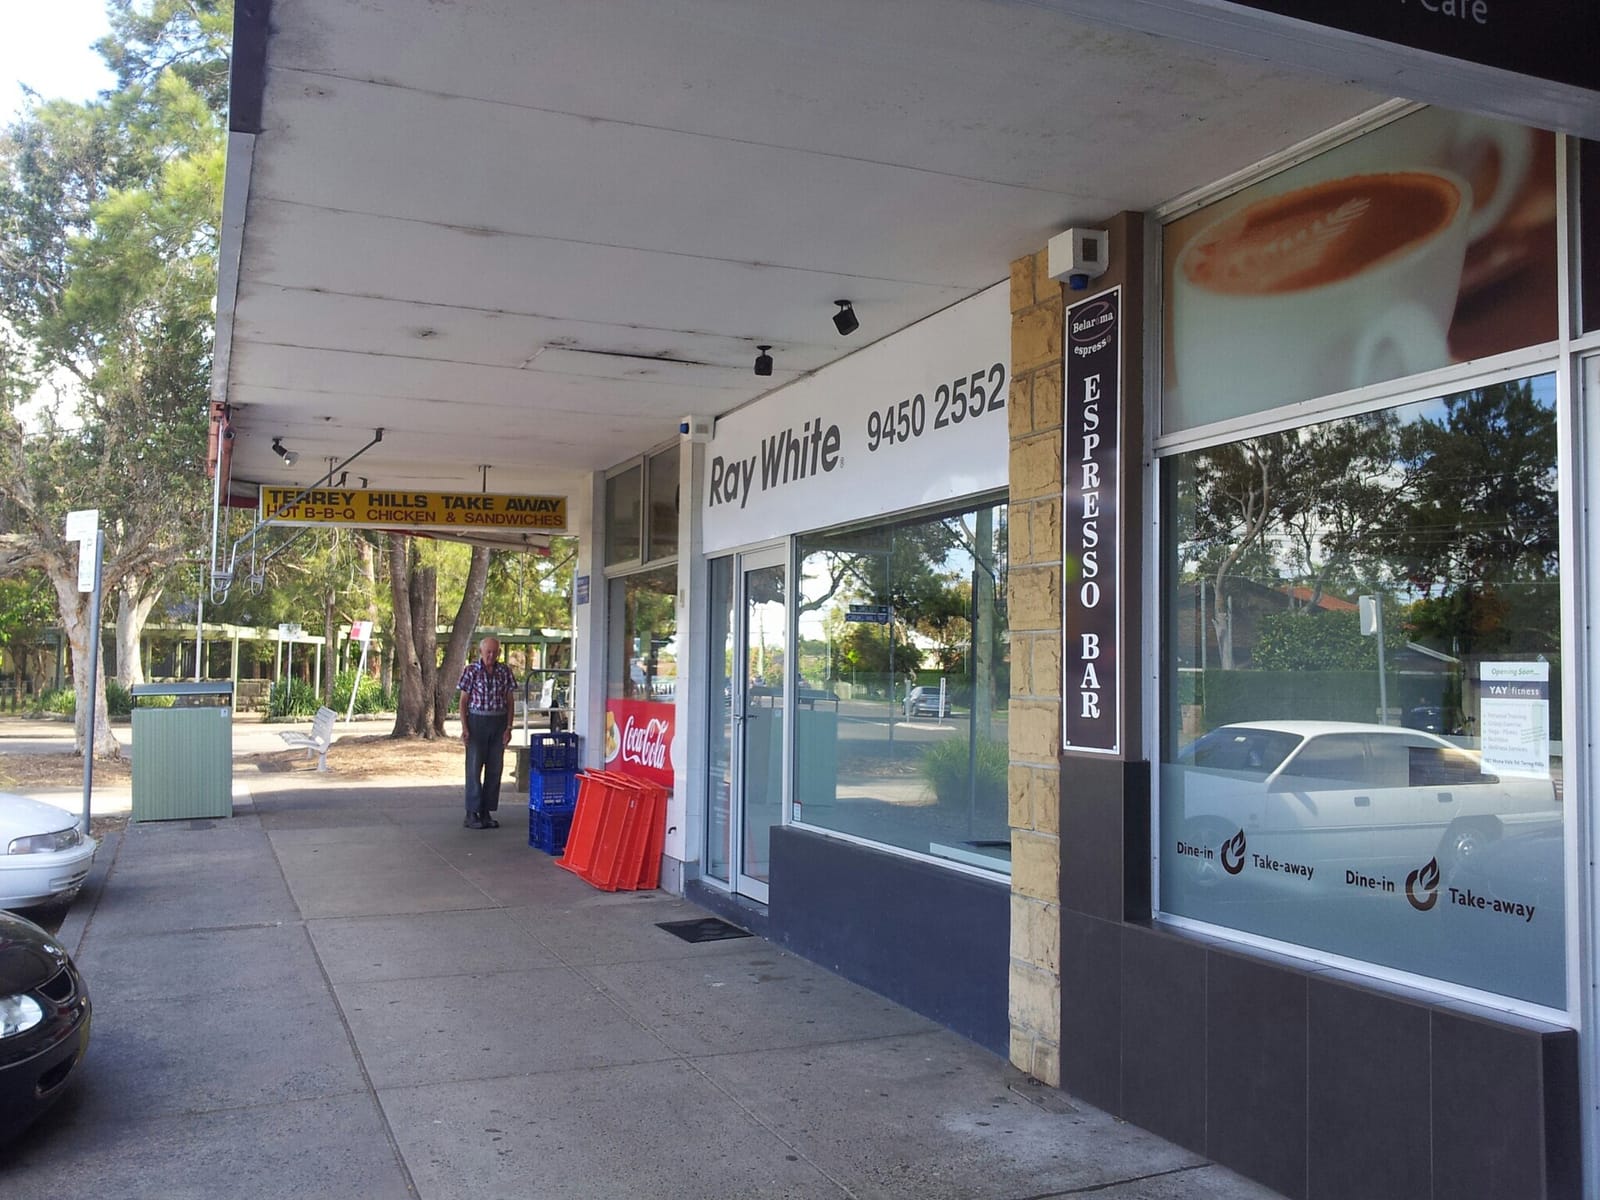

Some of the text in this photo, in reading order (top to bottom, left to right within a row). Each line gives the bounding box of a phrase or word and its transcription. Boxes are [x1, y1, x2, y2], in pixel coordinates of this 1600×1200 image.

[1072, 311, 1114, 334] Belaroma
[867, 362, 1006, 452] 9450 2552
[709, 416, 842, 509] Ray White
[266, 503, 564, 526] HOT B-B-Q CHICKEN & SANDWICHES
[268, 490, 561, 513] TERREY HILLS TAKE AWAY
[1080, 373, 1101, 719] ESPRESSO BAR
[1491, 667, 1518, 677] Opening
[1489, 686, 1540, 696] YAY fitness
[1176, 840, 1315, 881] Dine-in Take-away
[1345, 869, 1536, 923] Dine-in Take-away
